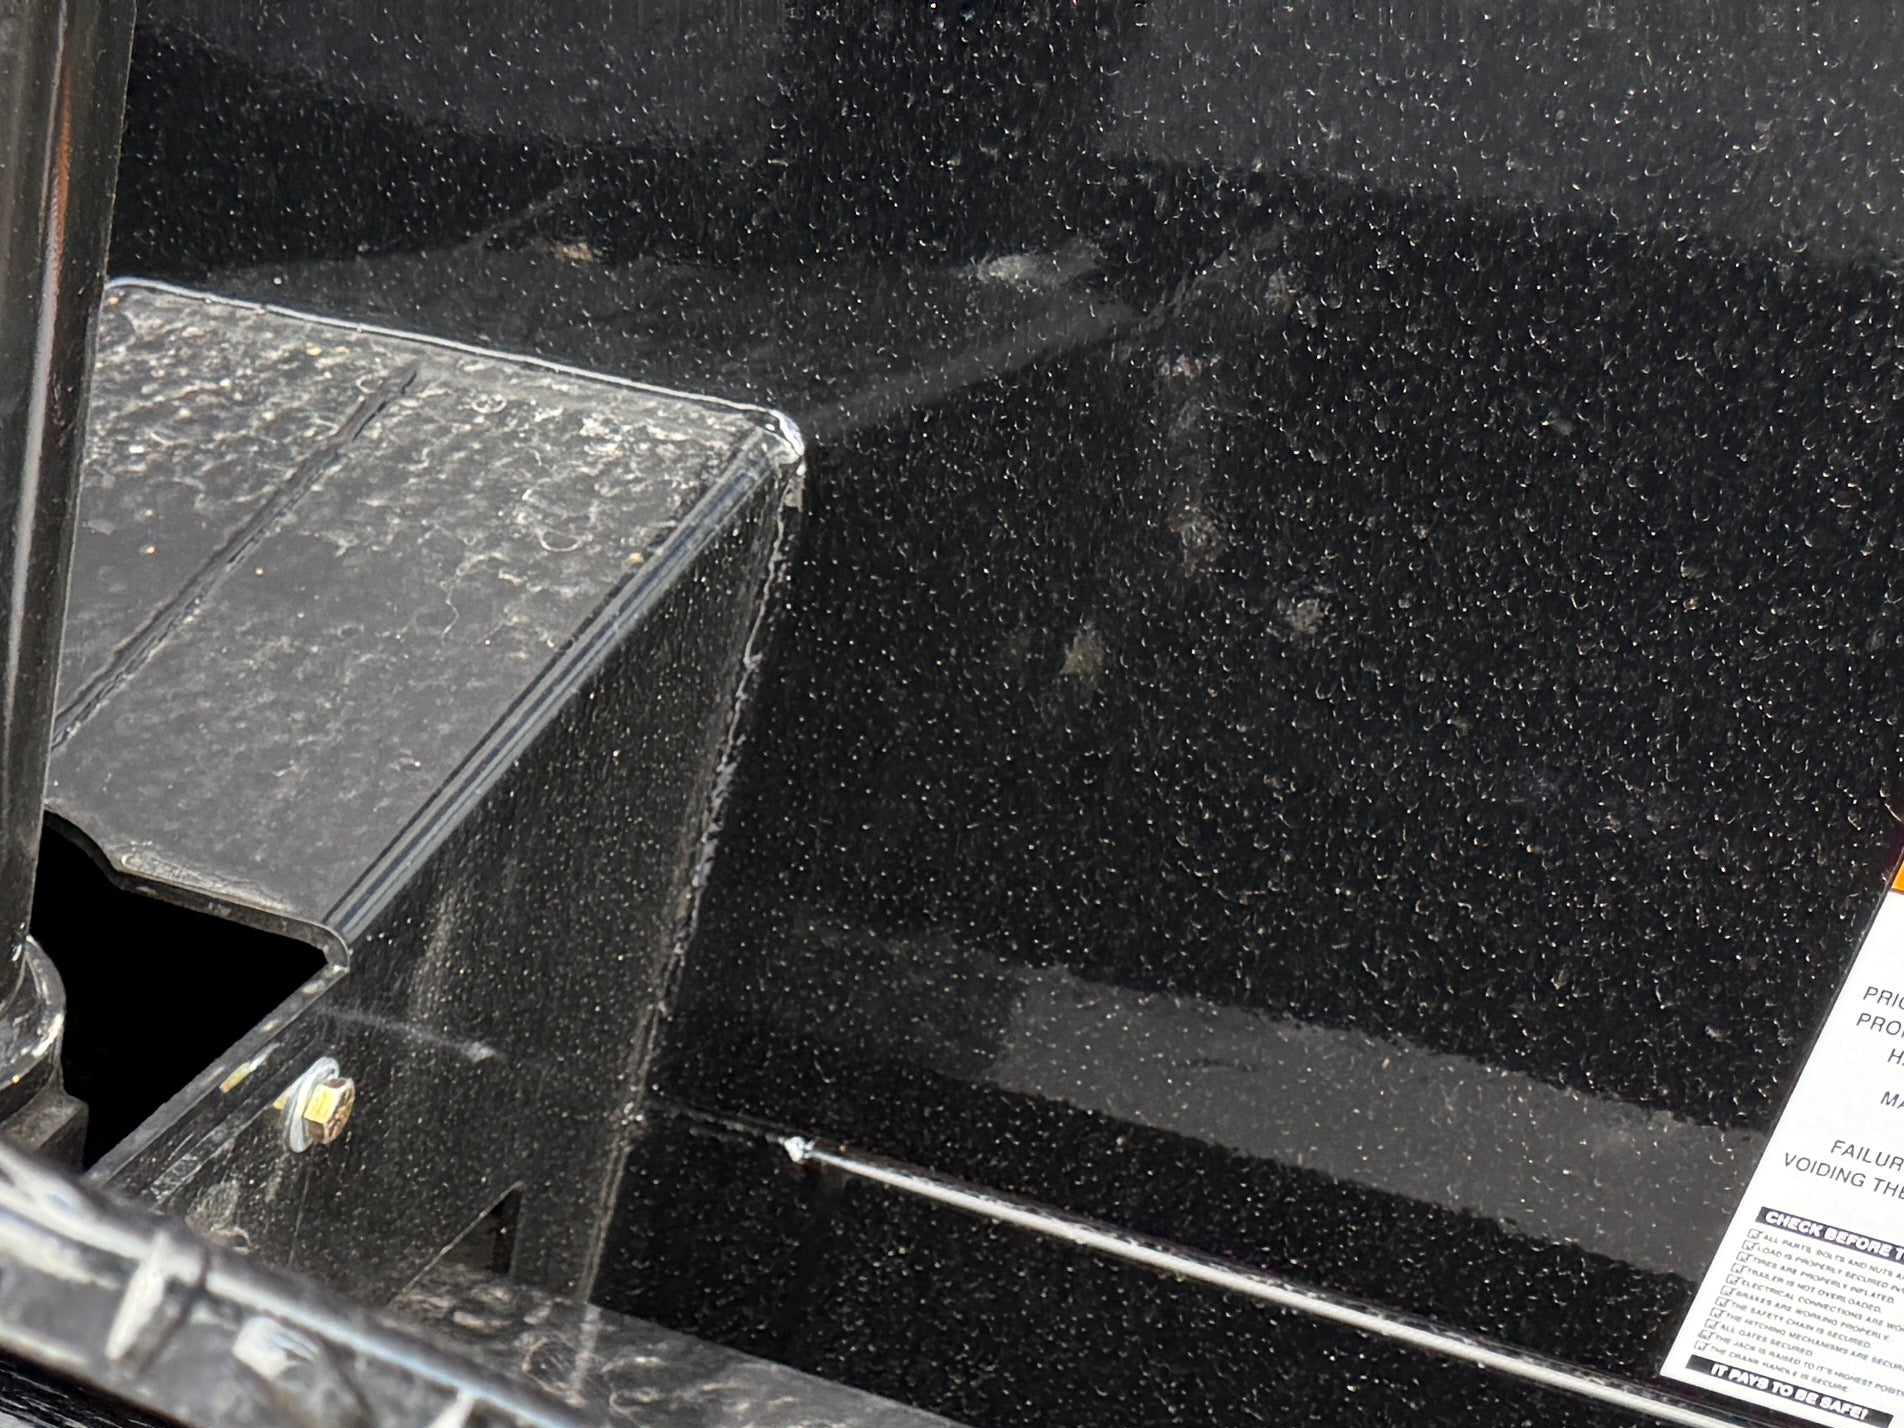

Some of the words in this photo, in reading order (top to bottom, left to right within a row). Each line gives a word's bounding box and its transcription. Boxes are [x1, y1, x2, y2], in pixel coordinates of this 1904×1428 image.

[1862, 985, 1904, 1011] PRI
[1856, 1011, 1904, 1039] PRO
[1781, 1151, 1867, 1188] VOIDING
[1763, 1210, 1823, 1237] CHECK
[1823, 1227, 1893, 1258] BEFORE
[1709, 1363, 1728, 1379] IT
[1727, 1368, 1770, 1391] PAYS
[1769, 1380, 1791, 1397] TO
[1793, 1387, 1818, 1405] BE
[1818, 1395, 1869, 1420] SAFE!
